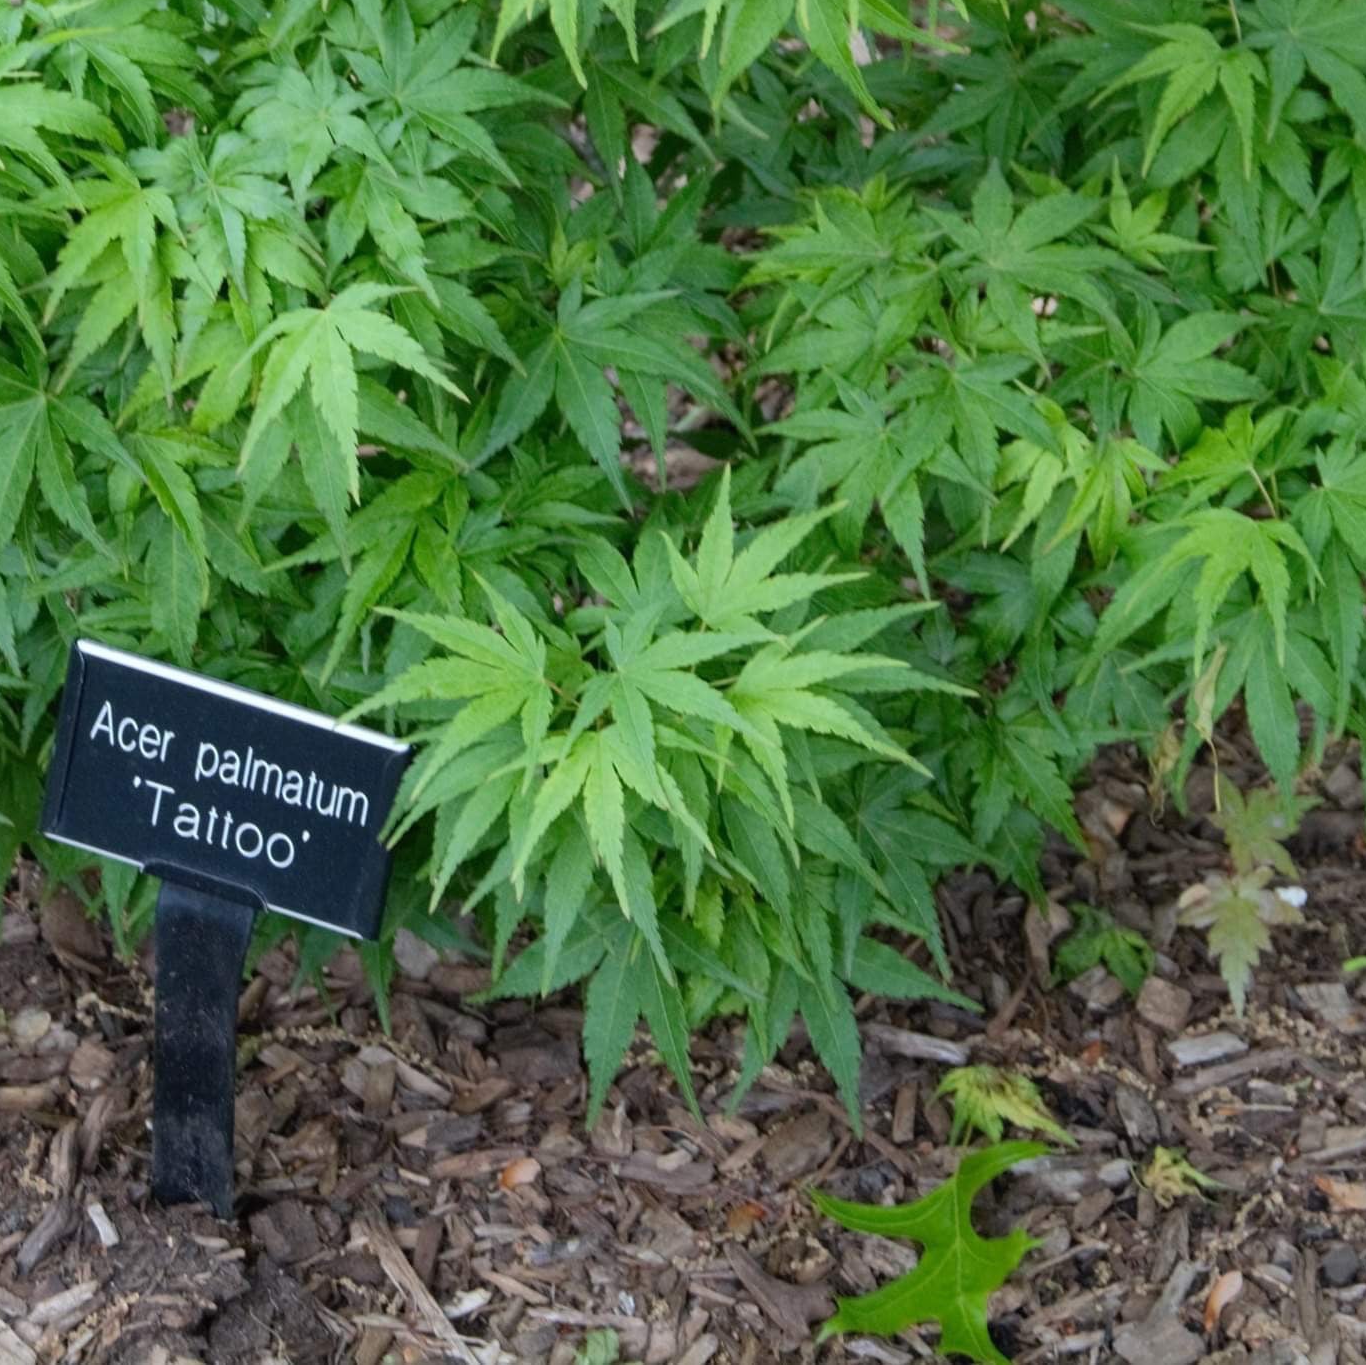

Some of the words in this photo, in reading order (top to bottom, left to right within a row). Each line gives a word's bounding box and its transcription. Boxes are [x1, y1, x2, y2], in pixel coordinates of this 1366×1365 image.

[90, 699, 176, 763] Acer
[195, 741, 370, 827] palmatum
[133, 776, 310, 868] 'Tattoo'
